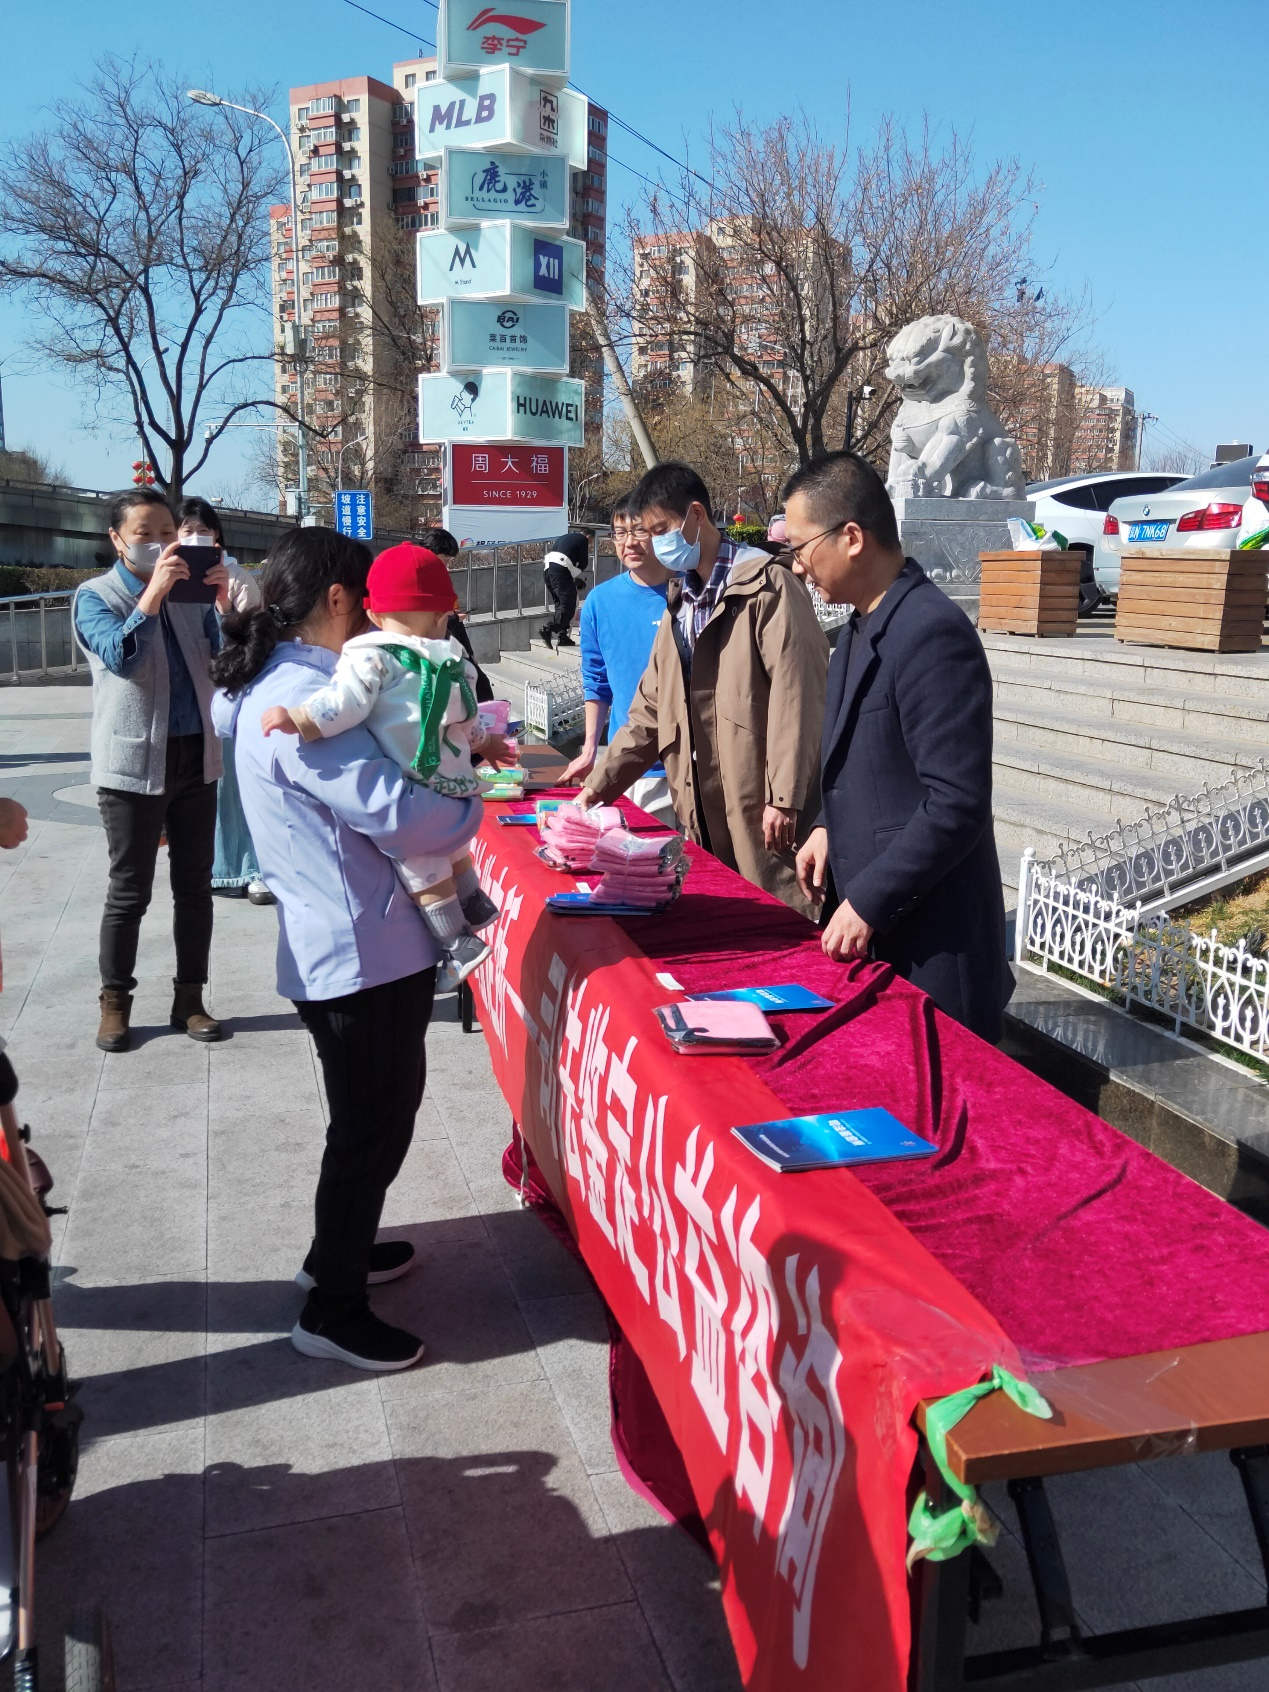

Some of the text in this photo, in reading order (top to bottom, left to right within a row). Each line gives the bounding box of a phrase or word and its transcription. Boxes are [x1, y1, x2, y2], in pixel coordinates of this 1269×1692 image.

[480, 35, 527, 56] 李宁
[429, 93, 497, 134] MLB
[479, 161, 540, 207] 鹿港
[449, 241, 477, 272] M
[488, 333, 528, 344] 菜百首饰
[516, 395, 579, 421] HUAWEI
[470, 453, 549, 474] 周大福
[483, 490, 538, 499] SINCE 1929
[356, 494, 367, 537] 注意安全
